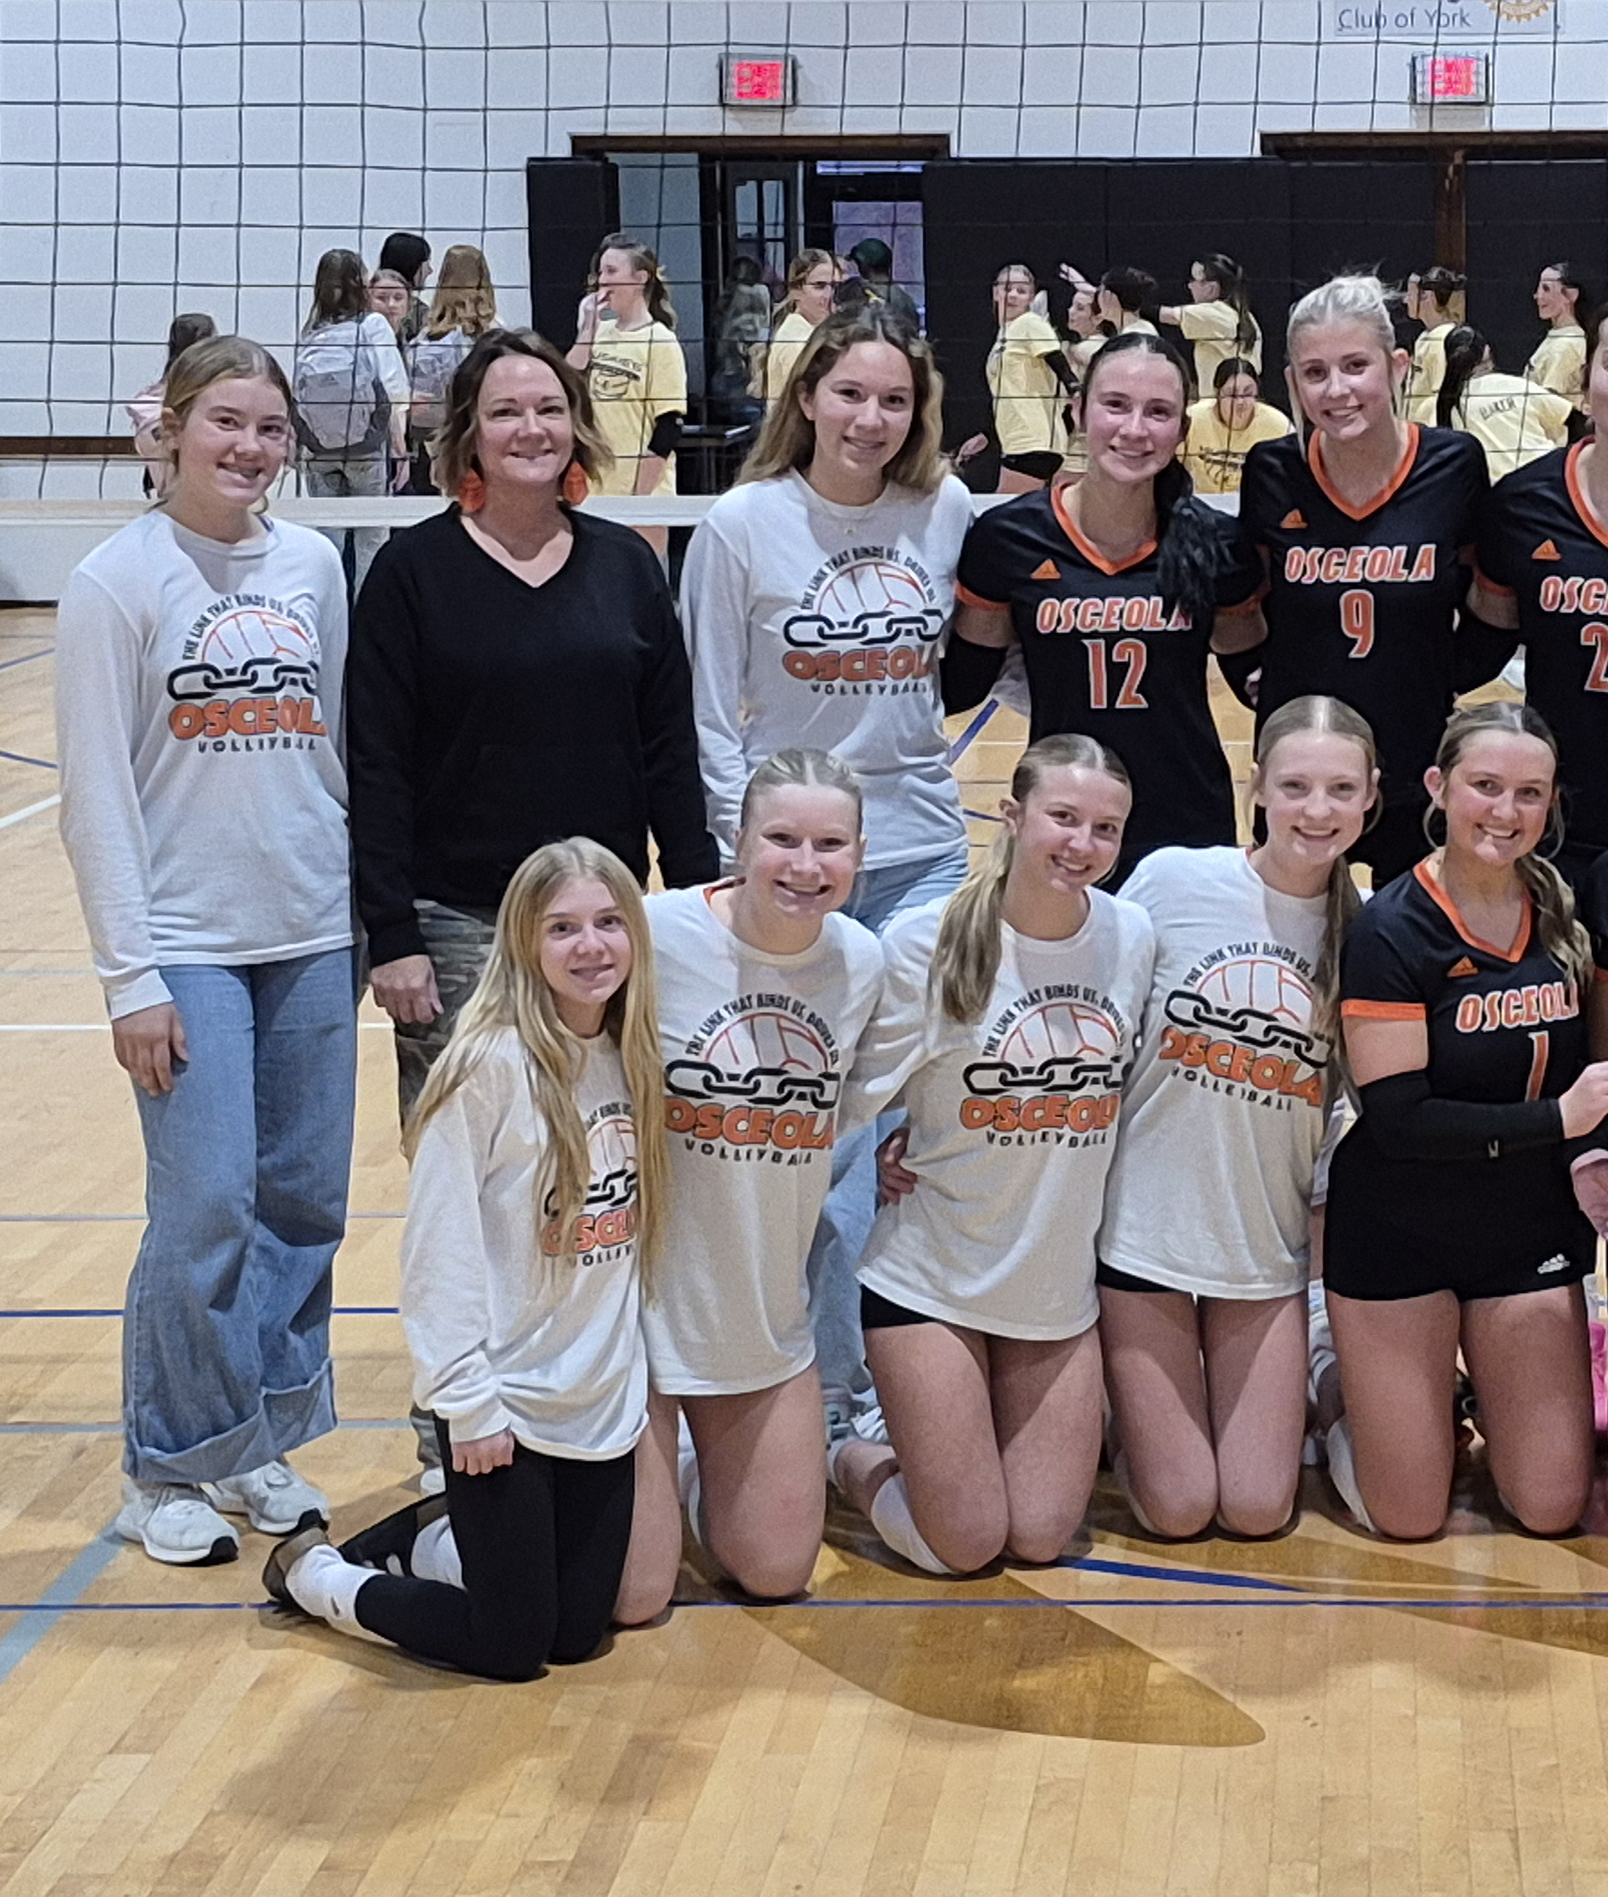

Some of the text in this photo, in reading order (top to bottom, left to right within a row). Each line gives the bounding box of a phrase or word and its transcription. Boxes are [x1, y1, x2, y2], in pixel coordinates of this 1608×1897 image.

[1338, 7, 1472, 29] Club of York
[1479, 397, 1516, 420] BAKER
[825, 550, 850, 571] THAT
[1284, 543, 1437, 584] OSCEOLA
[207, 596, 234, 620] THAT
[1036, 596, 1193, 634] OSCEOLA
[1339, 589, 1375, 658] 9
[782, 645, 934, 682] OSCEOL
[1081, 638, 1149, 709] 12
[168, 696, 327, 740] OSCEOL
[1199, 950, 1229, 970] LINK
[1227, 942, 1258, 959] THAT
[1262, 941, 1297, 965] BINDS
[701, 1011, 725, 1037] LINK
[723, 994, 752, 1017] THAT
[756, 993, 791, 1010] BINDS
[995, 1009, 1017, 1035] LINK
[1013, 989, 1044, 1013] THAT
[1044, 984, 1080, 998] BINDS
[1524, 1030, 1549, 1102] 1
